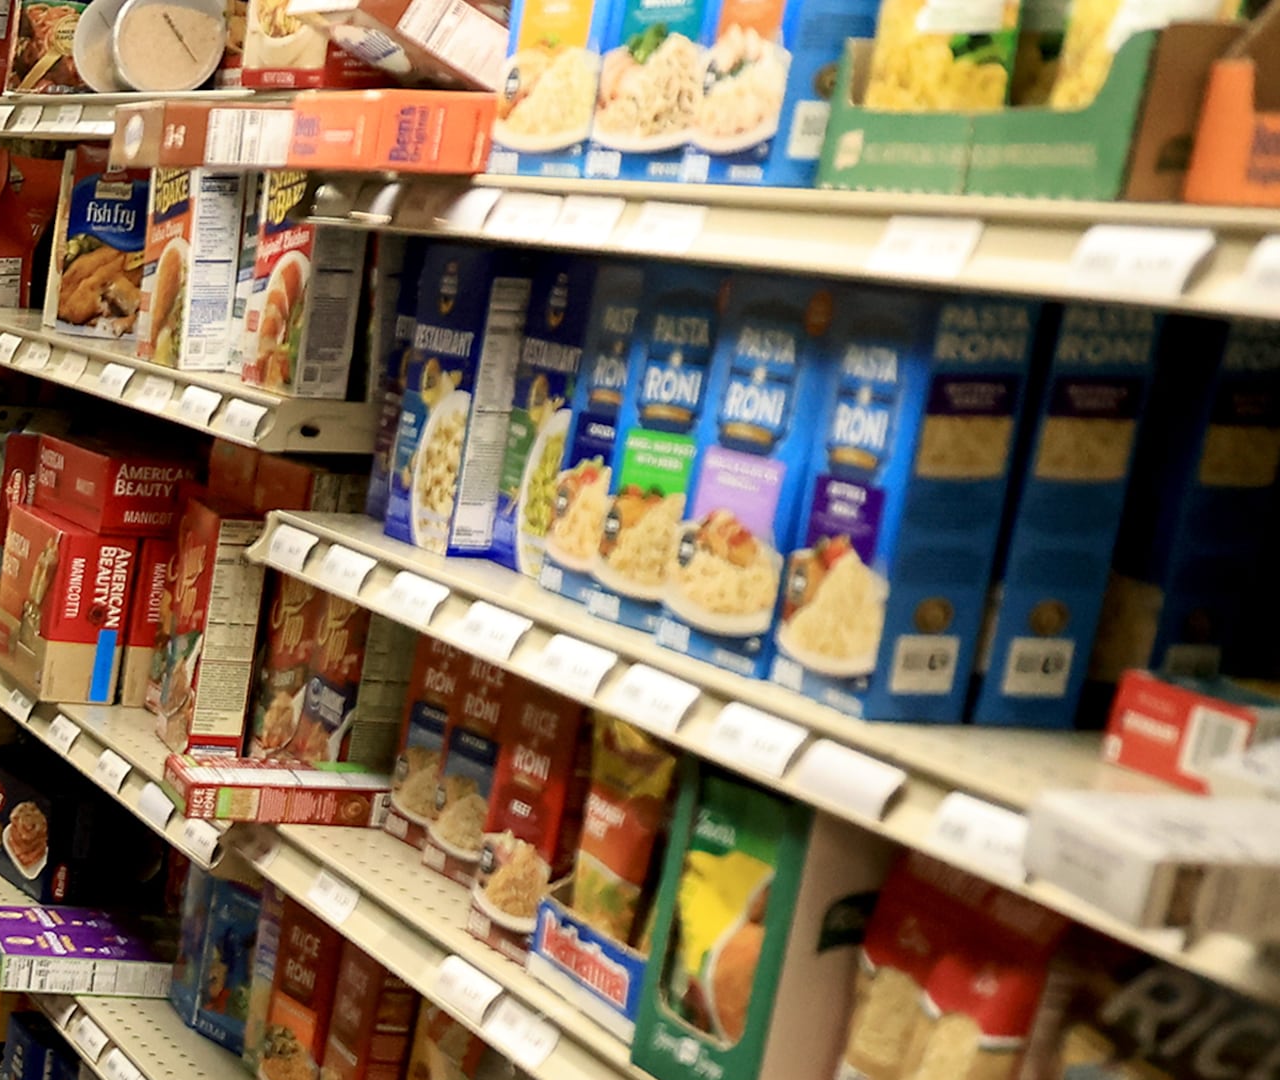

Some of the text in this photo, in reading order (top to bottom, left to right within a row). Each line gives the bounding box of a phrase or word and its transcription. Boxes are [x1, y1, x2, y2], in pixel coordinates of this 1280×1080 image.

[86, 202, 136, 231] fish fry
[740, 328, 796, 364] PASTA
[844, 344, 897, 383] PASTA
[646, 359, 700, 403] RONI
[726, 382, 786, 426] RONI
[836, 404, 888, 450] RONI
[114, 478, 173, 497] BEAUTY
[64, 557, 85, 619] MANICOTTI
[92, 545, 116, 606] BEAUTY
[105, 547, 132, 628] AMERICAN
[513, 746, 551, 782] RONI
